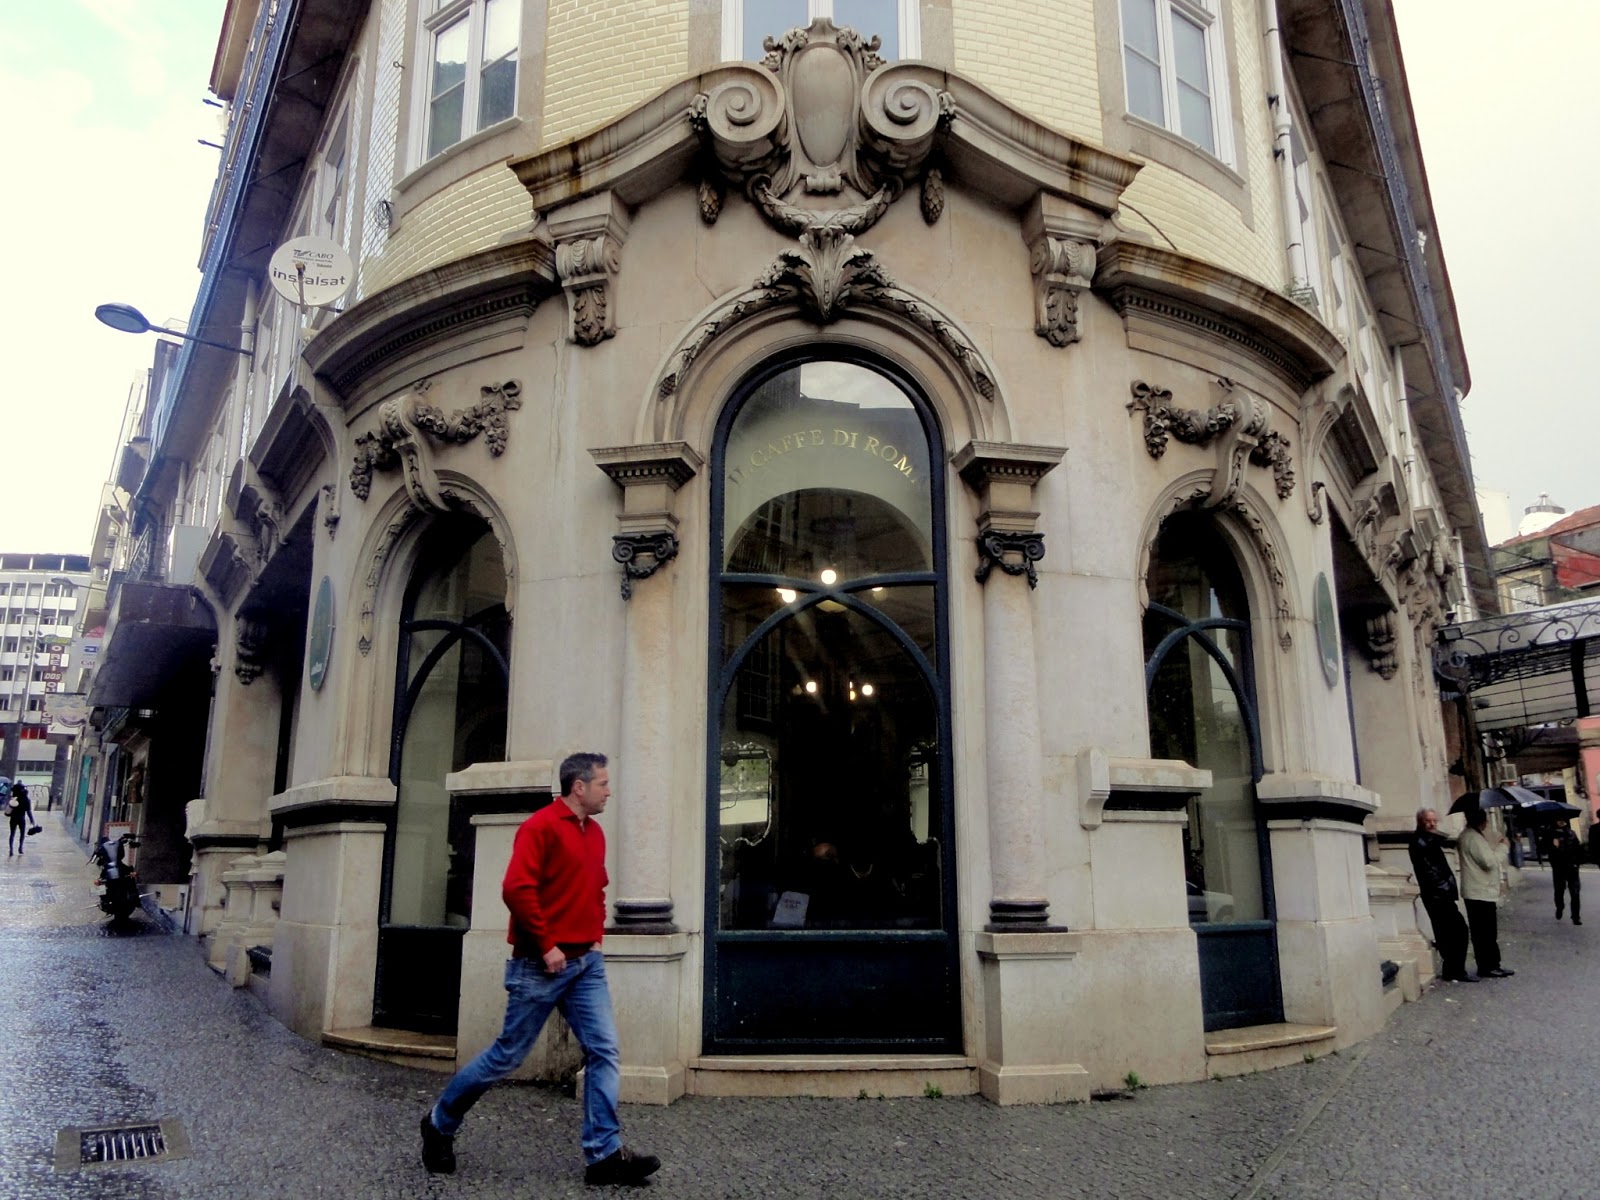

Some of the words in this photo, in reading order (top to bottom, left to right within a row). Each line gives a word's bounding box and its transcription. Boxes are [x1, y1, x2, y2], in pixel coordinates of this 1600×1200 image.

[273, 267, 346, 286] insalsat
[831, 429, 859, 448] DI
[863, 436, 918, 484] ROM
